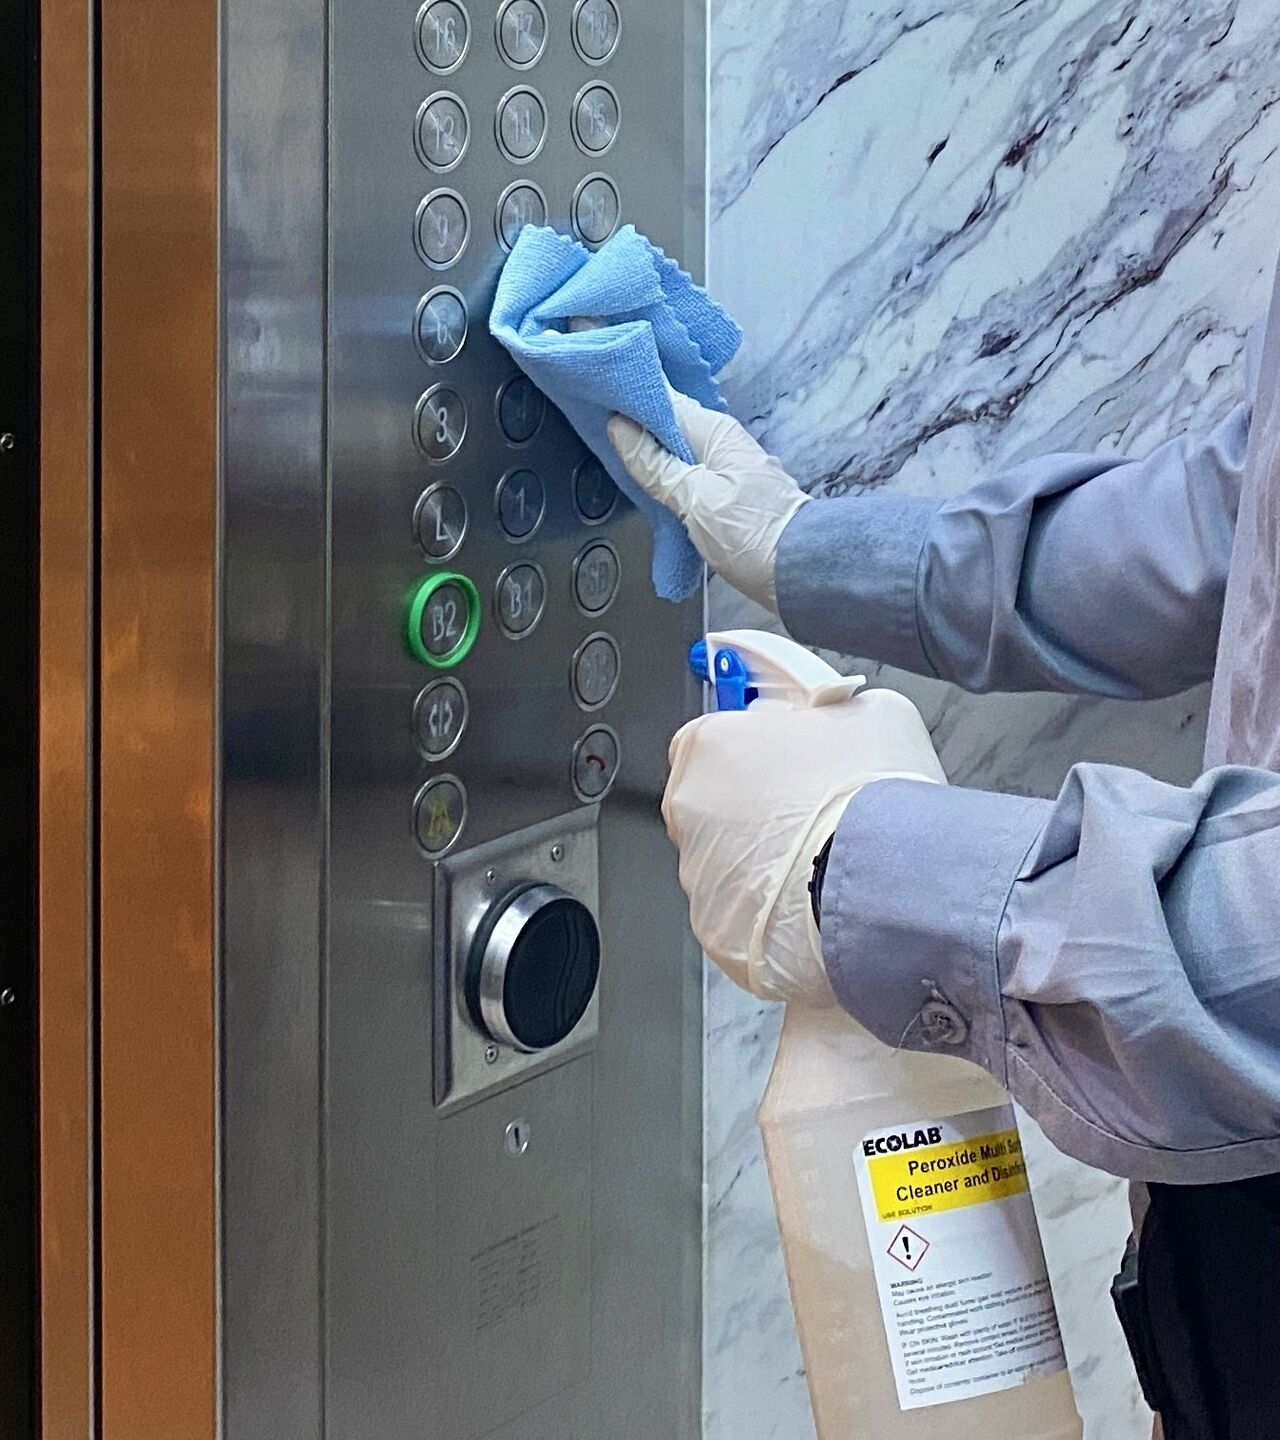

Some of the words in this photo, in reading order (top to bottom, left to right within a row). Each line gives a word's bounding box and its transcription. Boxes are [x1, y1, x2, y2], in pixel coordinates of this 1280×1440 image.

[436, 407, 448, 443] 3
[516, 486, 526, 521] 1
[510, 579, 533, 618] B1
[432, 600, 457, 642] B2
[862, 1127, 942, 1157] ECOLAB
[908, 1149, 977, 1176] Peroxide
[980, 1143, 1007, 1160] Multi
[896, 1179, 960, 1202] Cleaner
[964, 1170, 989, 1188] and
[898, 1204, 932, 1218] SOLUTION
